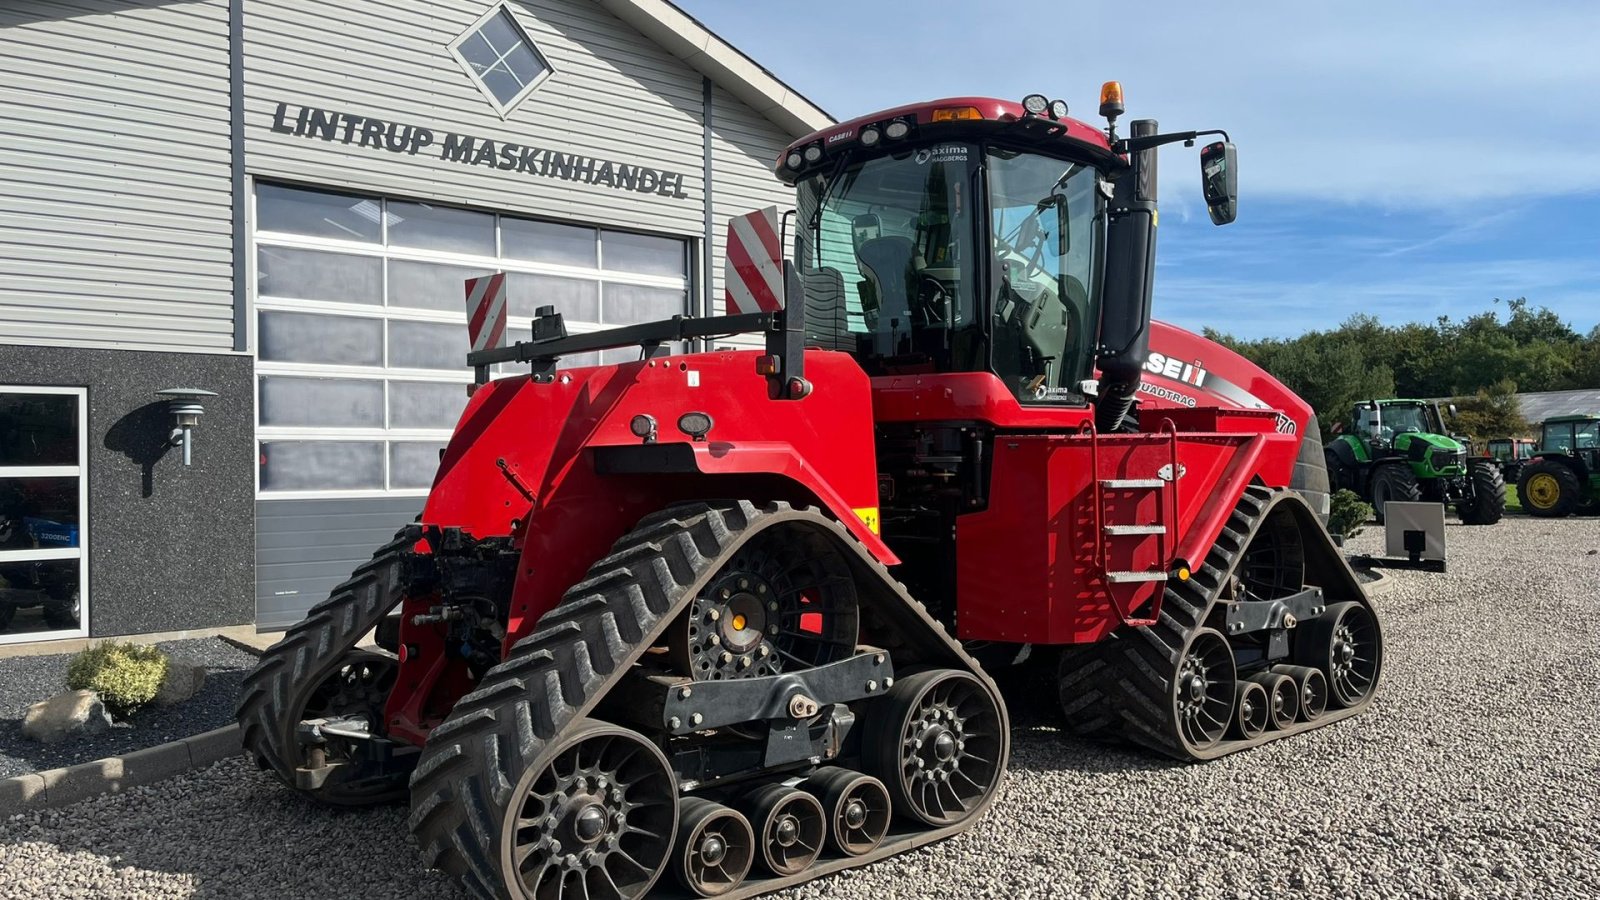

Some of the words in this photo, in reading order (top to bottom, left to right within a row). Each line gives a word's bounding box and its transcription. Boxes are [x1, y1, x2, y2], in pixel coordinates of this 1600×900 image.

[270, 102, 434, 156] LINTRUP
[440, 132, 688, 200] MASKINHANDEL
[1139, 382, 1196, 408] UADTRAC
